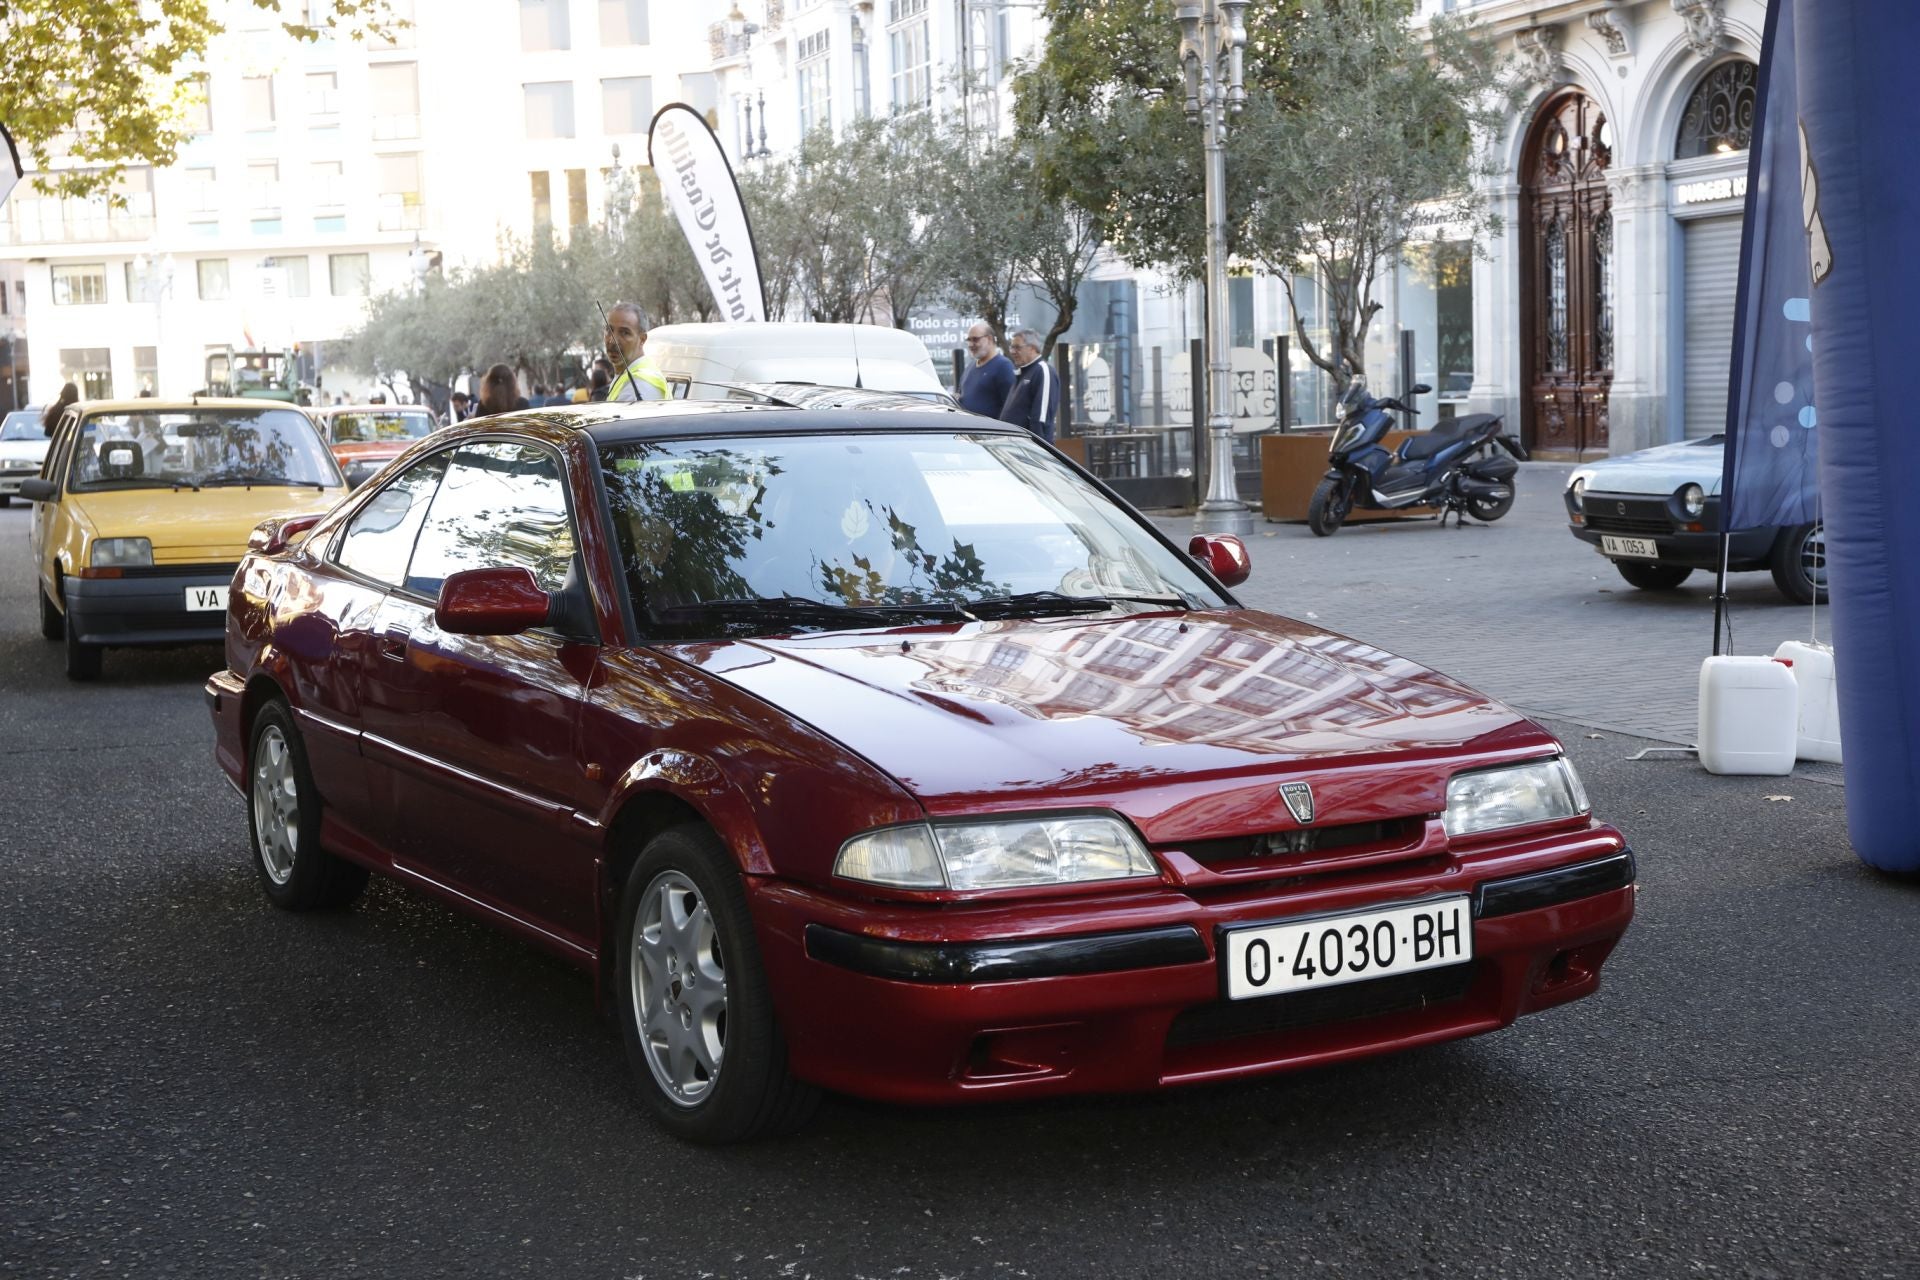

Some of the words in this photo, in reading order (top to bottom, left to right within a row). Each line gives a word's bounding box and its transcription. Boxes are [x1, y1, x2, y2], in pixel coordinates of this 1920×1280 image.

[1679, 179, 1733, 204] BURGER
[1733, 176, 1748, 197] KI
[909, 317, 941, 329] Todo
[943, 318, 959, 328] es
[917, 331, 958, 343] uando
[1604, 537, 1618, 552] VA
[1622, 539, 1646, 554] 1053
[1650, 541, 1656, 555] J
[196, 590, 219, 607] VA
